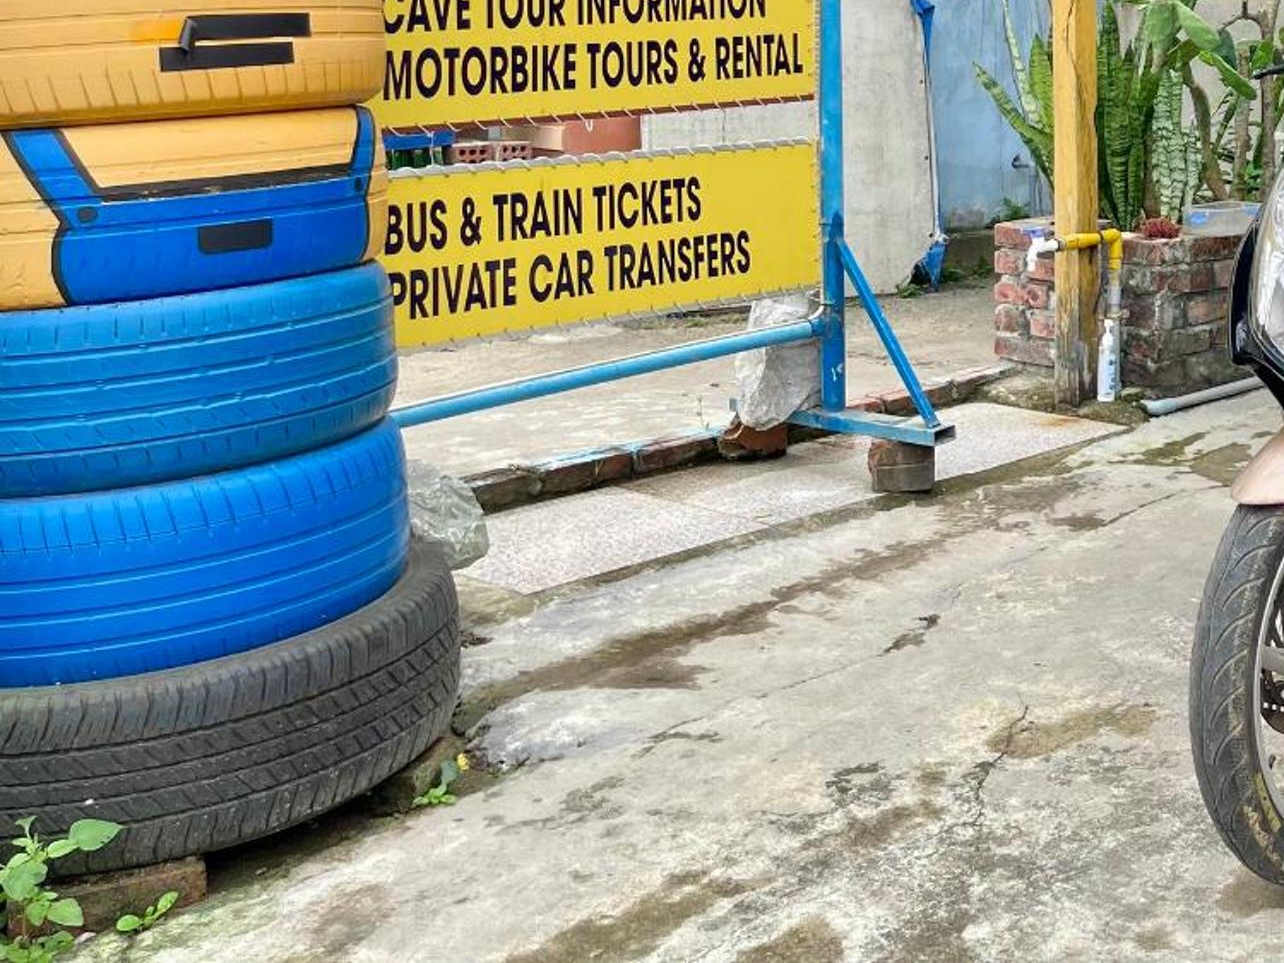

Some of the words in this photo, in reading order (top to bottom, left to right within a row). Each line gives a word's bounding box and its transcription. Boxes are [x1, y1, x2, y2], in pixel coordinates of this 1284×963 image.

[383, 41, 577, 101] MOTORBIKE
[586, 38, 678, 89] TOURS
[688, 37, 706, 81] &
[715, 33, 803, 80] RENTAL
[384, 199, 448, 256] BUS
[460, 197, 482, 247] &
[492, 188, 583, 242] TRAIN
[592, 176, 701, 232] TICKETS
[387, 256, 517, 320] PRIVATE
[529, 249, 595, 304] CAR
[603, 230, 751, 292] TRANSFERS
